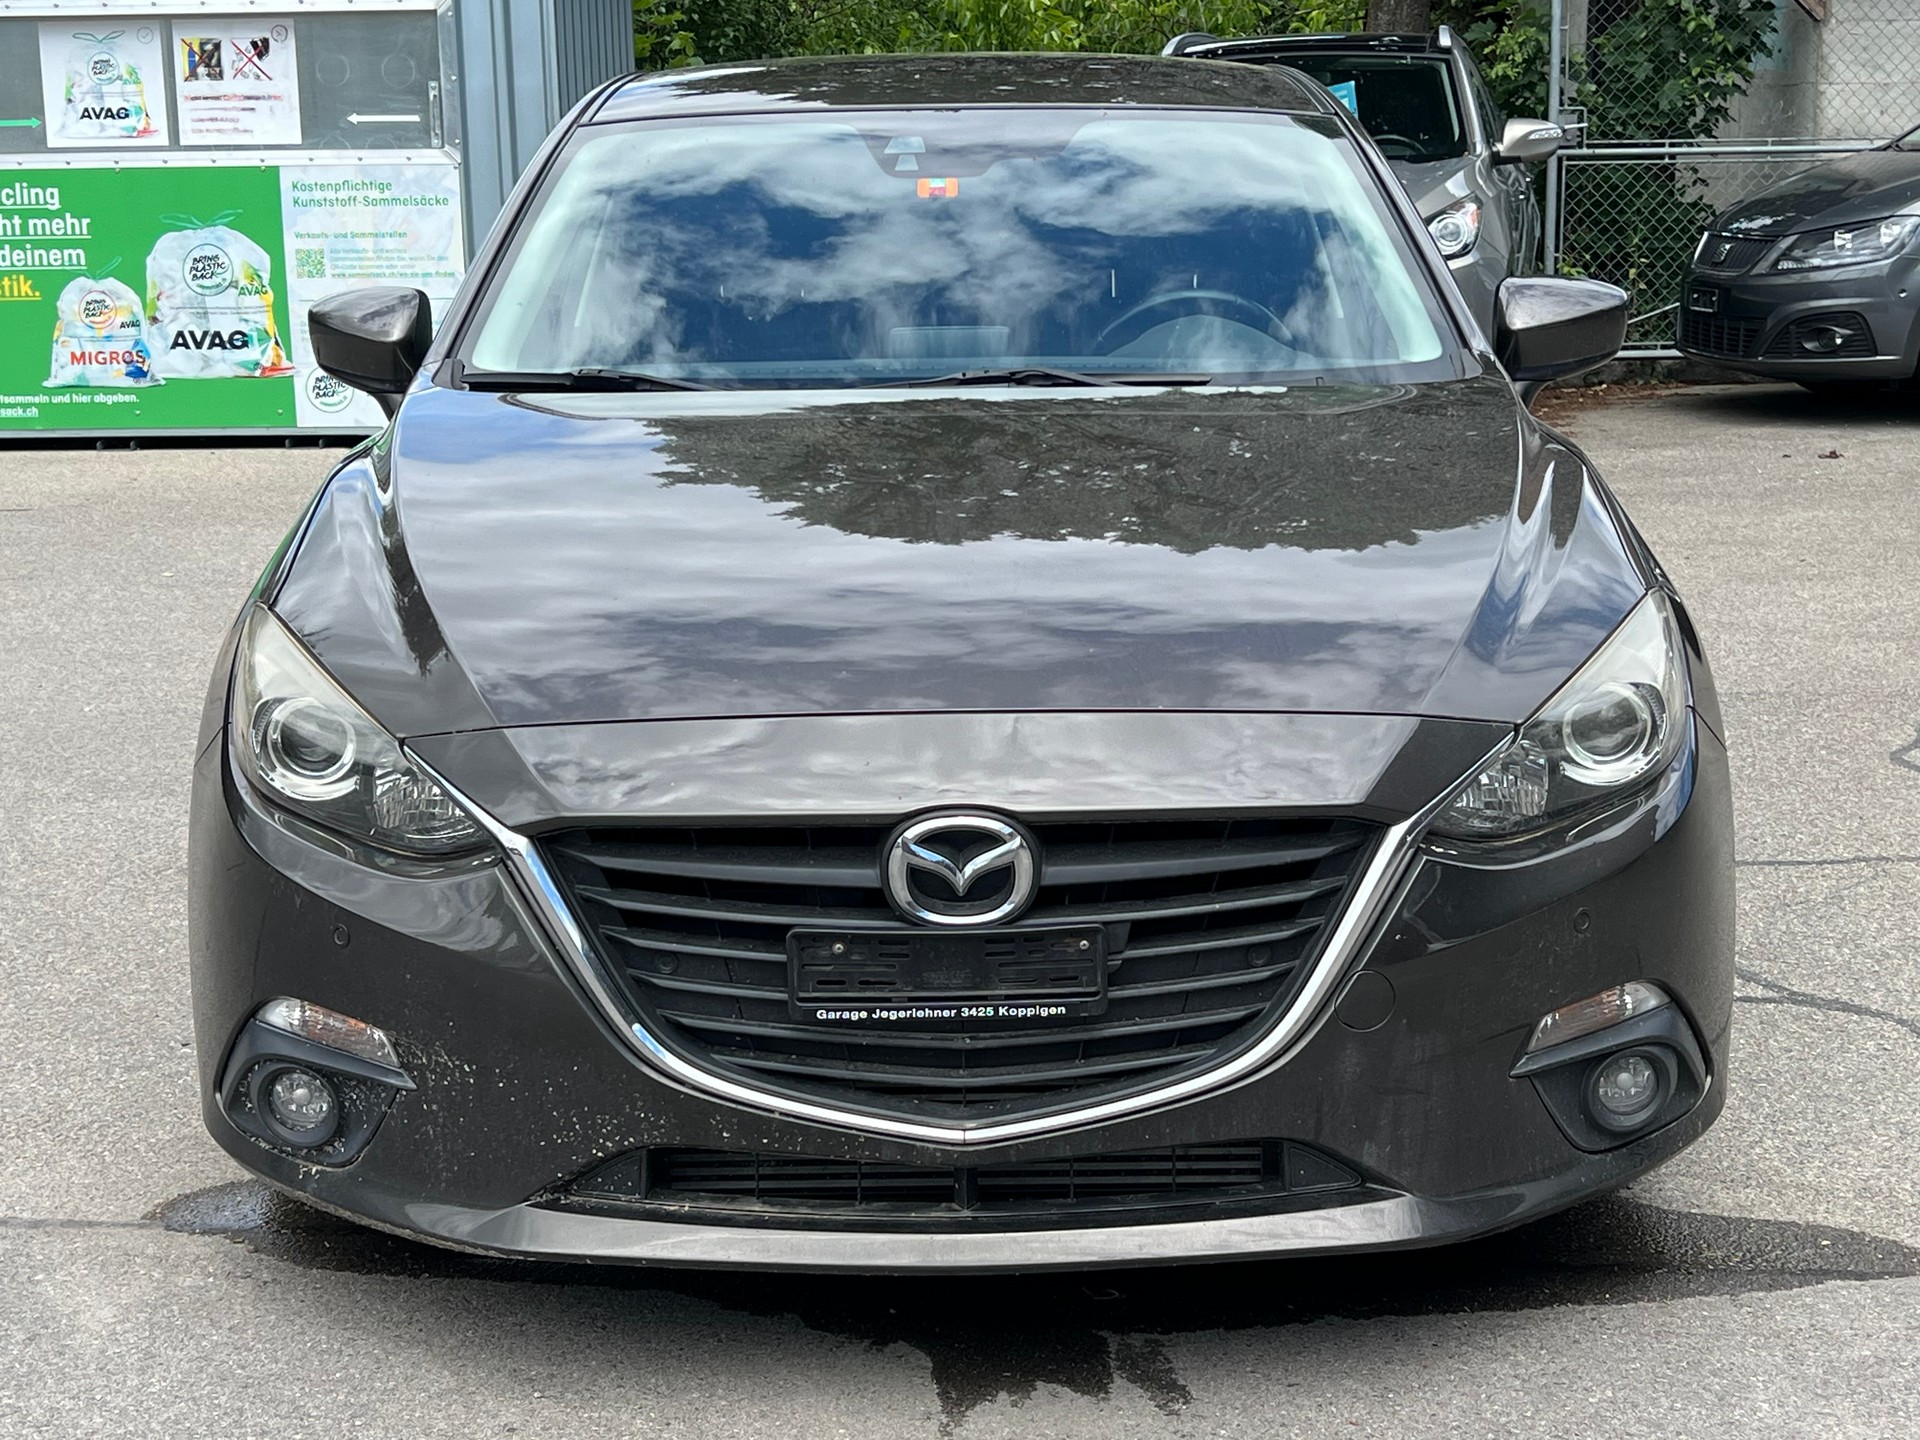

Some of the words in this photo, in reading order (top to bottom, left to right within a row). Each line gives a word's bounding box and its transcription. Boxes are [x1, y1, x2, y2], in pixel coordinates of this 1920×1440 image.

[80, 107, 130, 120] AVAG
[292, 180, 393, 194] Kostenpflichtige
[293, 195, 449, 207] Kunststoff-Sammelsäcke
[29, 212, 91, 236] mehr
[350, 231, 408, 239] Sammelstellen
[0, 243, 86, 267] deinem
[192, 255, 220, 265] BRING
[189, 262, 226, 275] PLASTIC
[238, 284, 268, 297] AVAG
[119, 319, 141, 330] AVAG
[170, 330, 249, 350] AVAG
[70, 350, 147, 366] MIGROS
[51, 393, 70, 404] und
[72, 393, 92, 403] hier
[93, 393, 140, 405] abgeben.
[816, 1009, 868, 1021] Garage
[872, 1008, 957, 1021] Jegerlehner
[960, 1007, 994, 1017] 3425
[998, 1005, 1066, 1018] Koppigen
